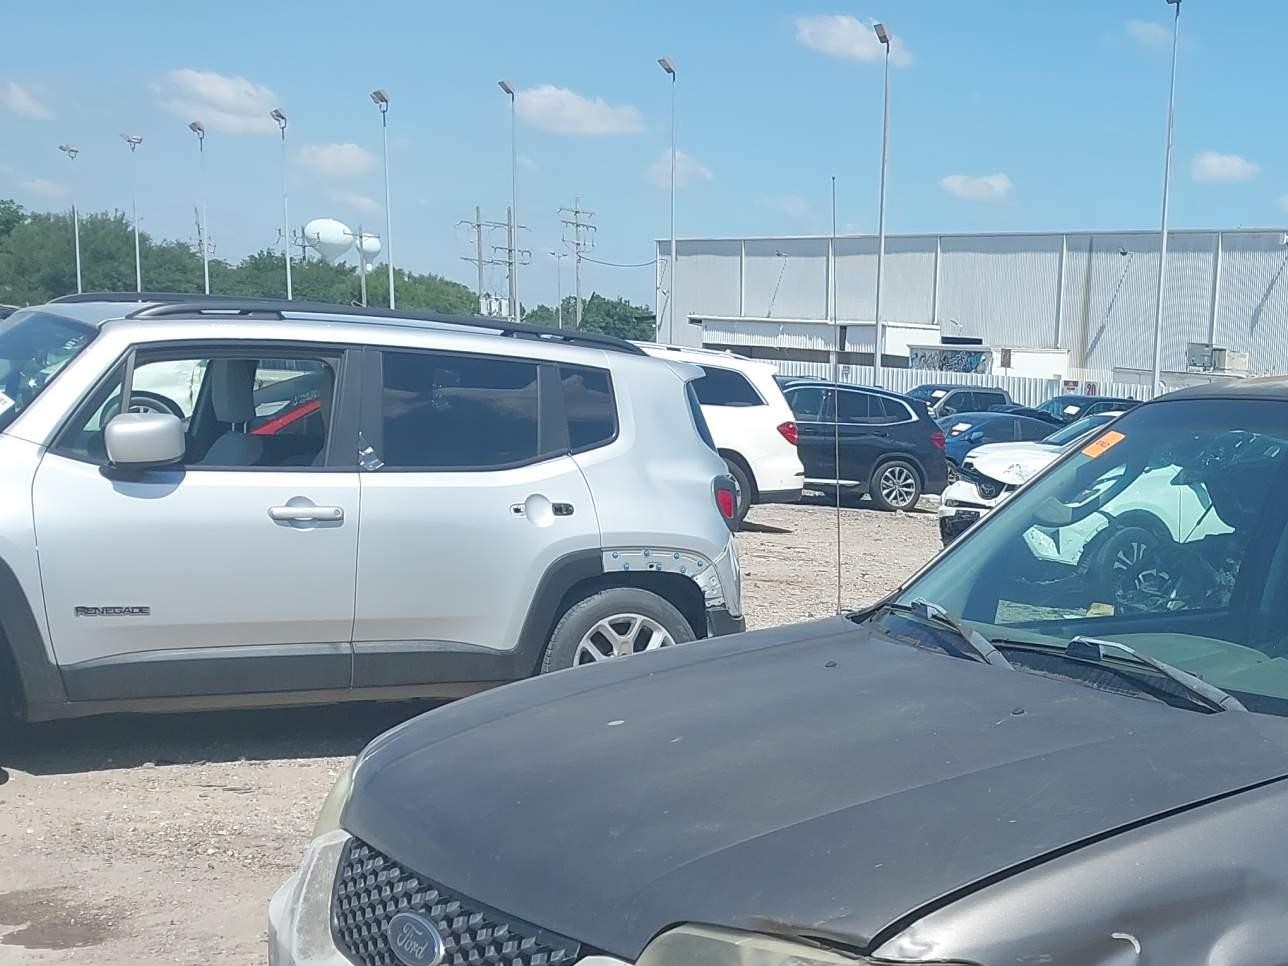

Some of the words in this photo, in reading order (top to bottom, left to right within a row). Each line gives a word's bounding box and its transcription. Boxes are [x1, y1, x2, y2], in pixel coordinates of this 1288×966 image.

[1087, 383, 1096, 396] 20
[74, 605, 151, 617] RENEGADE
[396, 922, 428, 959] Ford
